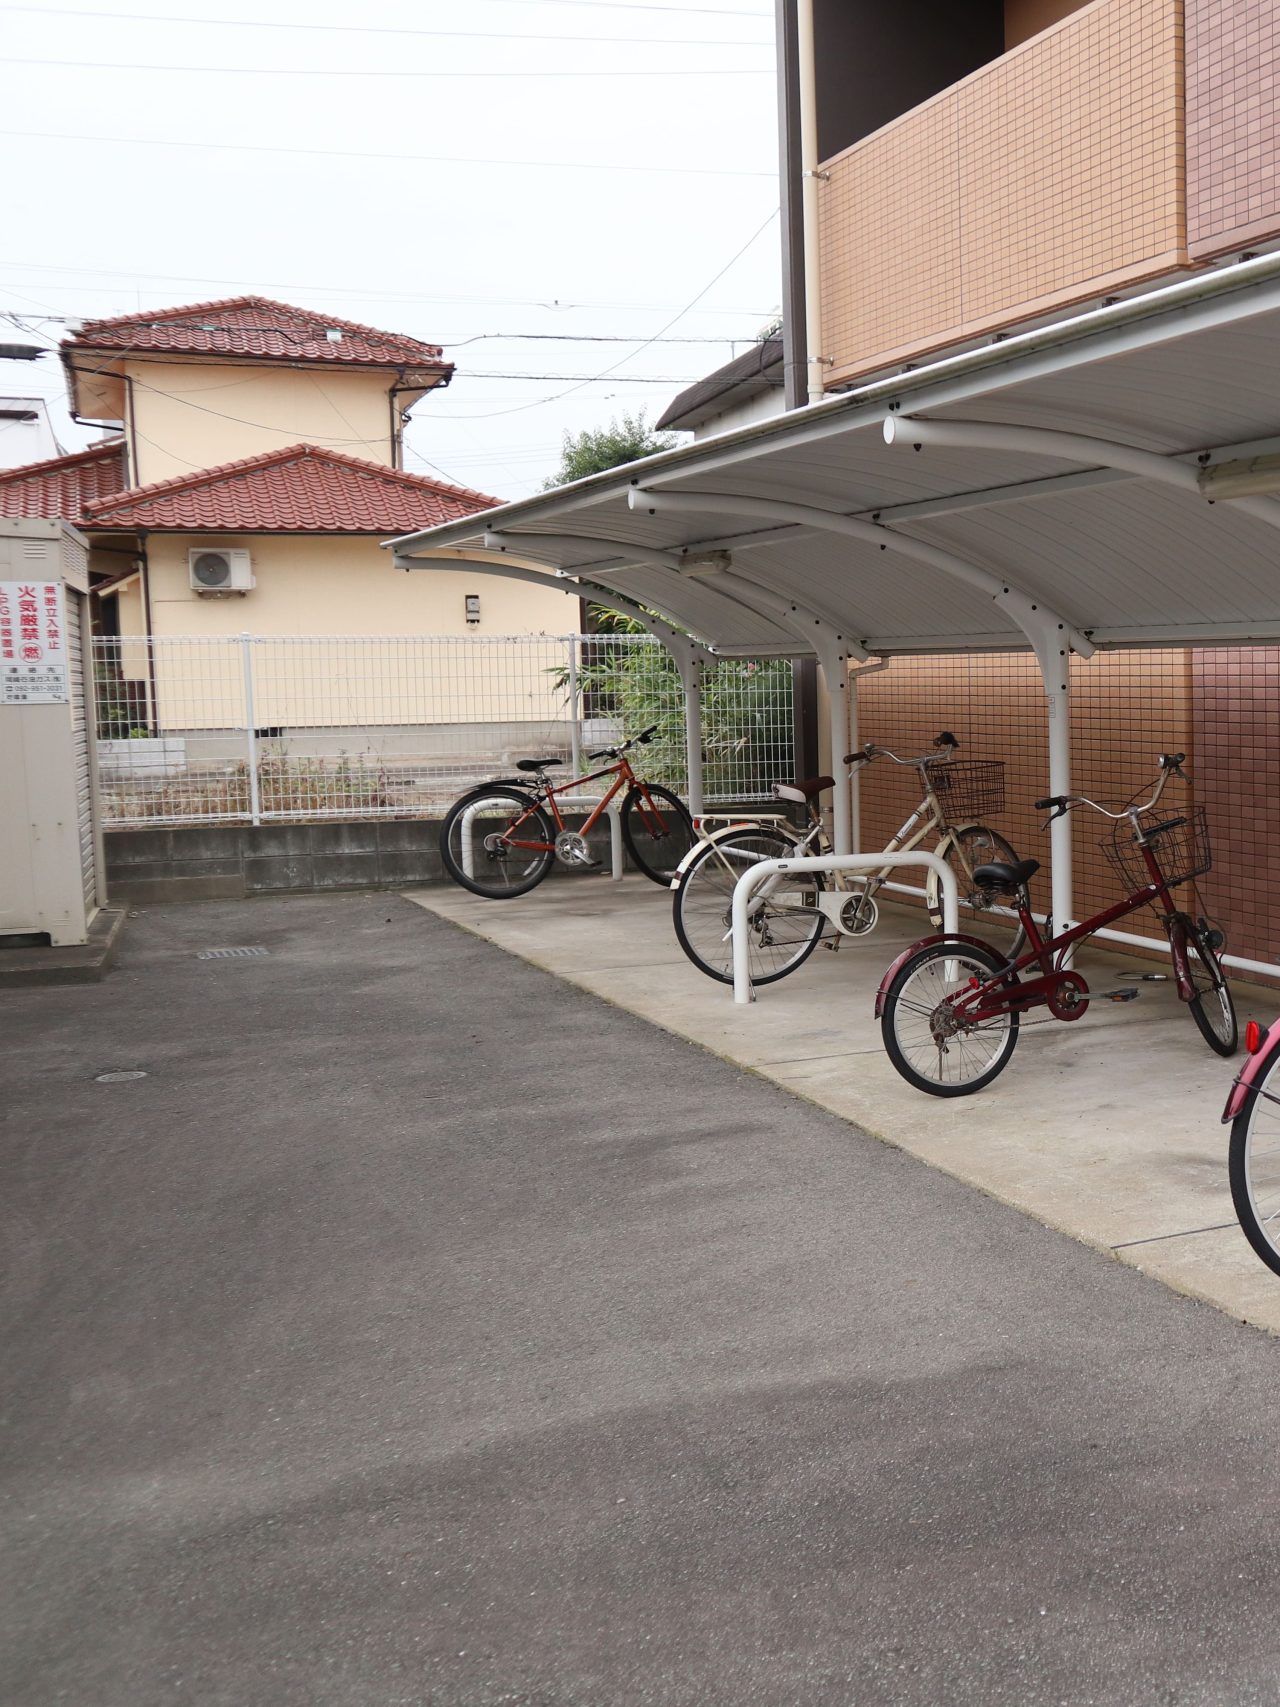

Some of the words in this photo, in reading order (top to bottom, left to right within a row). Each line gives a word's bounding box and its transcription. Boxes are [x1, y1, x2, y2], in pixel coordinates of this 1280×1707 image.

[18, 585, 40, 640] 火気厳禁
[44, 586, 60, 650] 無断立入禁止
